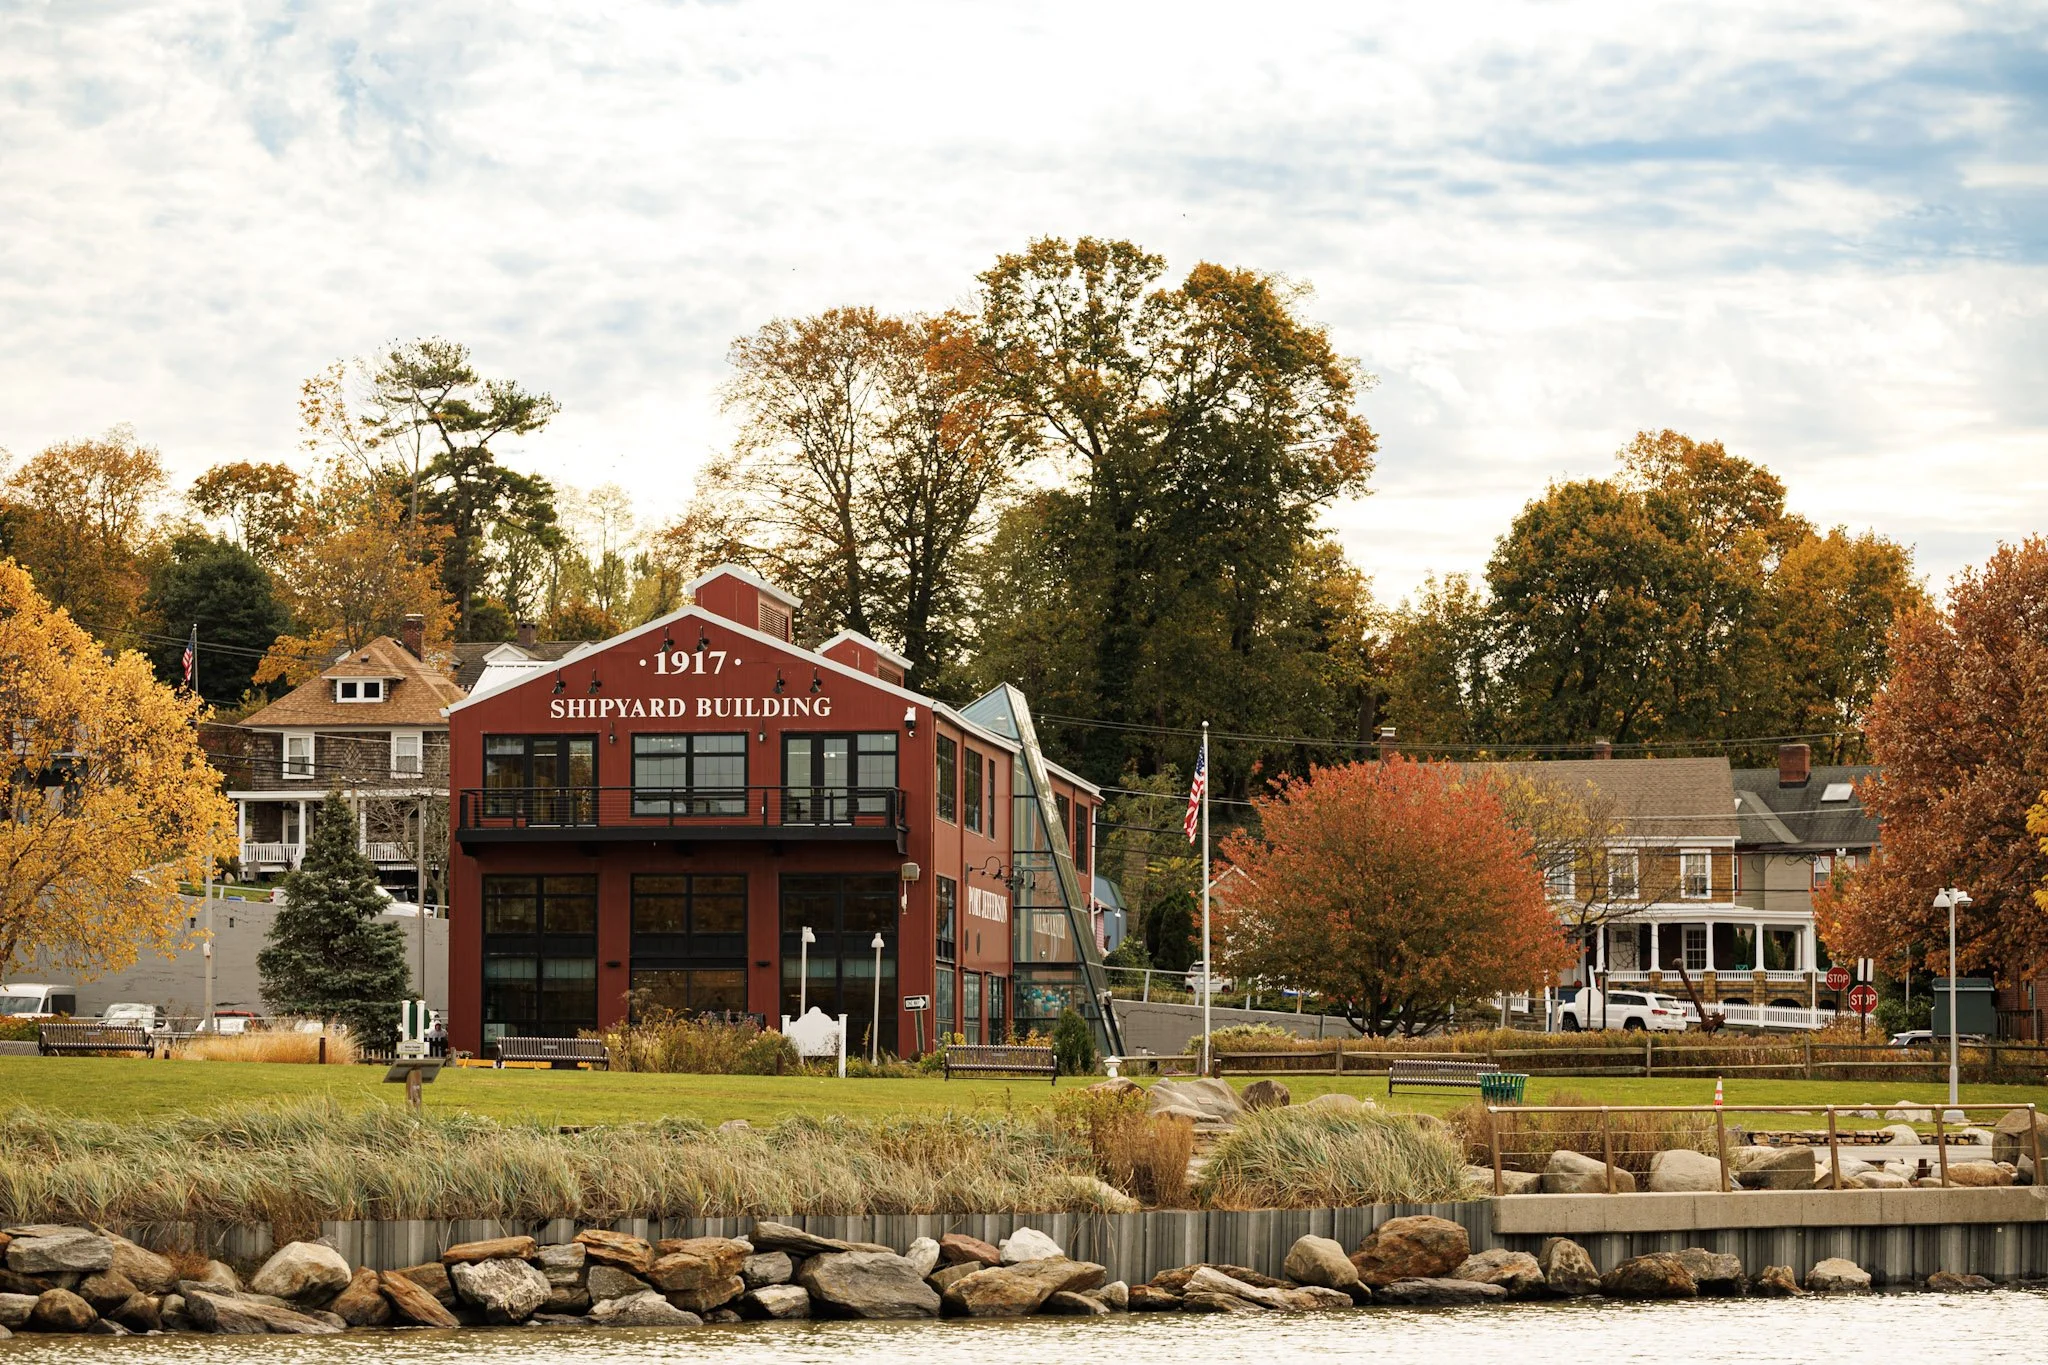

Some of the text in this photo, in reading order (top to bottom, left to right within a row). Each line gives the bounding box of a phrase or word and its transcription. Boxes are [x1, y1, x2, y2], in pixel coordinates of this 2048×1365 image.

[653, 650, 727, 675] 1917
[550, 697, 832, 719] SHIPYARD BUILDING
[968, 885, 982, 917] PORT
[1827, 973, 1849, 984] STOP
